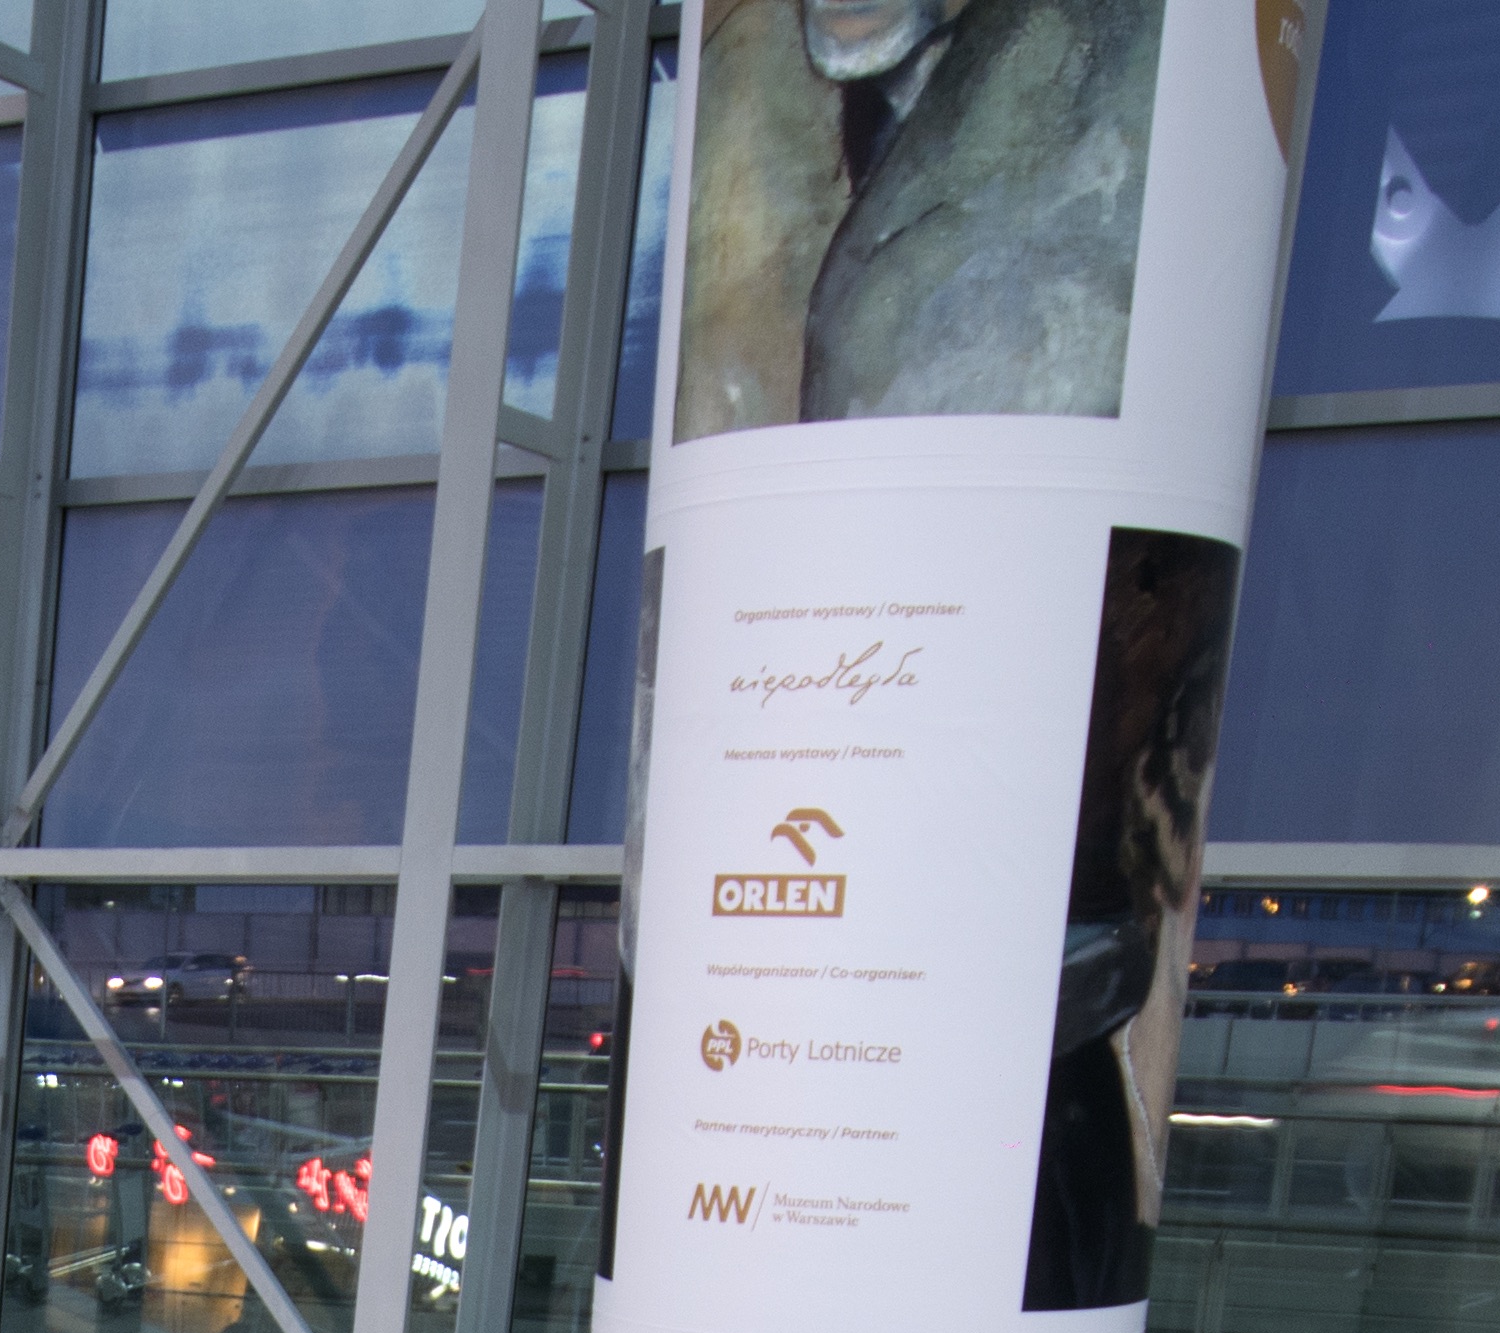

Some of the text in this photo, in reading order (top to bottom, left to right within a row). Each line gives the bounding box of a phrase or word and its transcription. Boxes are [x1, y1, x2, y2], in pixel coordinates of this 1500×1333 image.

[734, 607, 809, 623] Organizator
[812, 603, 875, 621] wystawy
[724, 747, 777, 761] Mecenas
[779, 746, 840, 762] wystawy
[851, 746, 905, 760] Patron:
[717, 879, 838, 913] ORLEN
[707, 963, 819, 980] Współorganizator
[747, 1038, 802, 1064] Porty
[807, 1039, 902, 1064] Lotnicze
[694, 1119, 738, 1135] Partner
[739, 1122, 831, 1141] merytoryczny
[774, 1193, 833, 1211] Muzeum
[836, 1195, 911, 1213] Narodowe
[772, 1211, 860, 1228] w Warszawie
